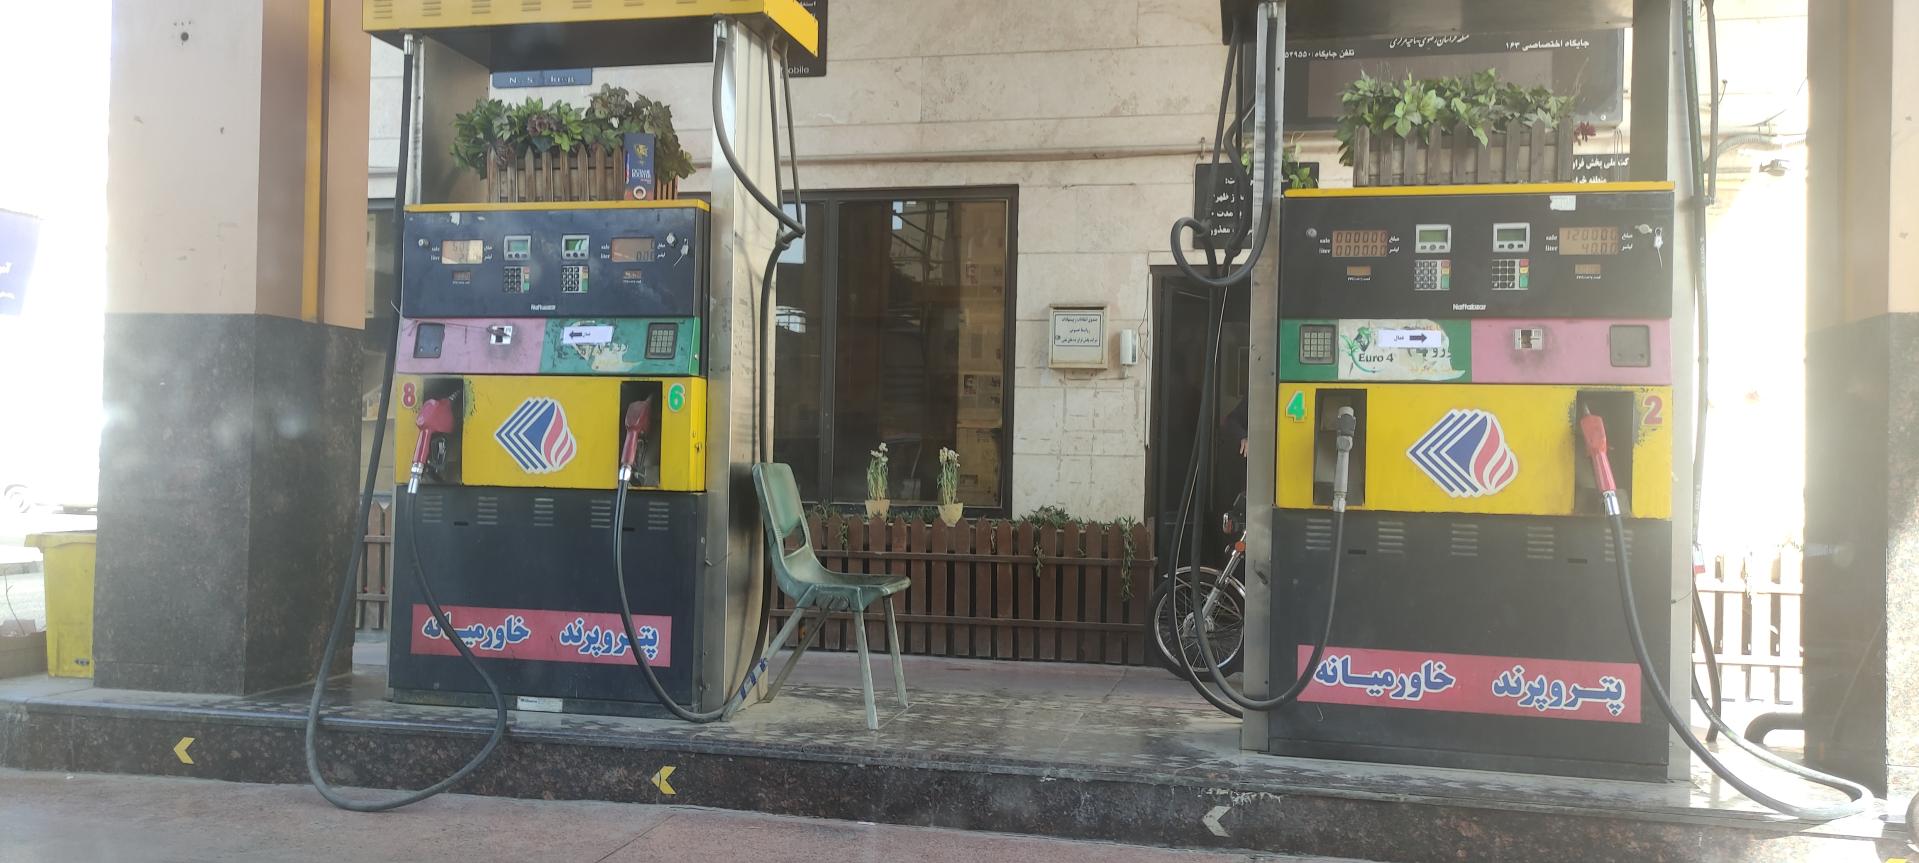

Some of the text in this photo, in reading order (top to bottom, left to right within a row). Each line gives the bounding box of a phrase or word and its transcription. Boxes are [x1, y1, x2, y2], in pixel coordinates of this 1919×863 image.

[1339, 49, 1355, 59] تلفن
[1522, 40, 1563, 52] اختصاصی
[1564, 38, 1590, 50] جایگاه
[1358, 353, 1394, 362] Euro 4
[402, 381, 417, 408] 8
[668, 382, 686, 412] 6
[1286, 390, 1307, 422] 4
[1642, 394, 1664, 426] 2
[1314, 655, 1455, 700] خاورمیانه
